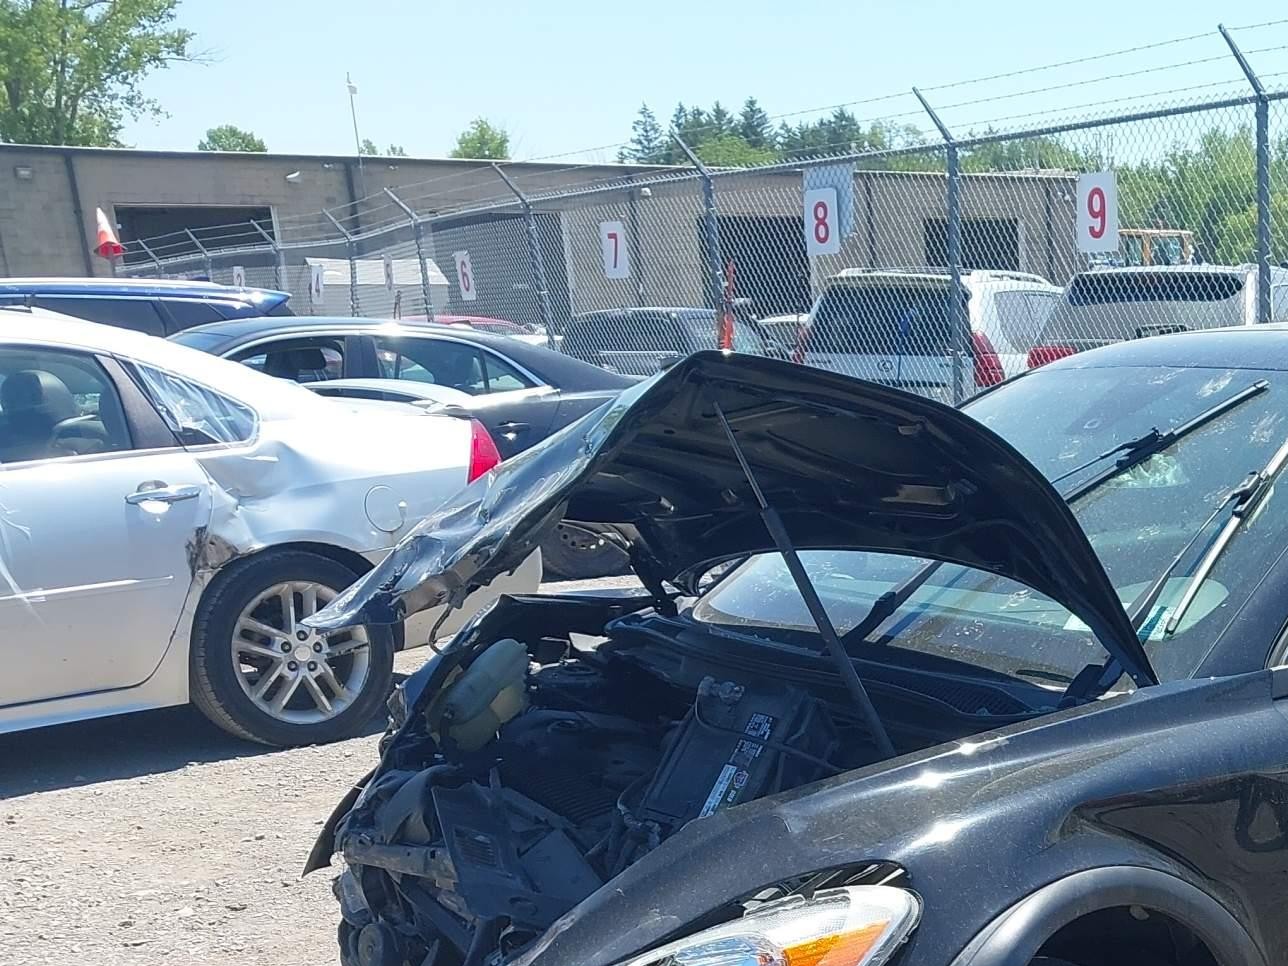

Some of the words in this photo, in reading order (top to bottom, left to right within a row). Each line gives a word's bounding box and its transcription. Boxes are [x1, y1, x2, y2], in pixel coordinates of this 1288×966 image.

[813, 200, 830, 244] 8
[1087, 186, 1106, 240] 9
[607, 232, 618, 269] 7
[313, 272, 322, 298] 4
[459, 259, 471, 293] 6
